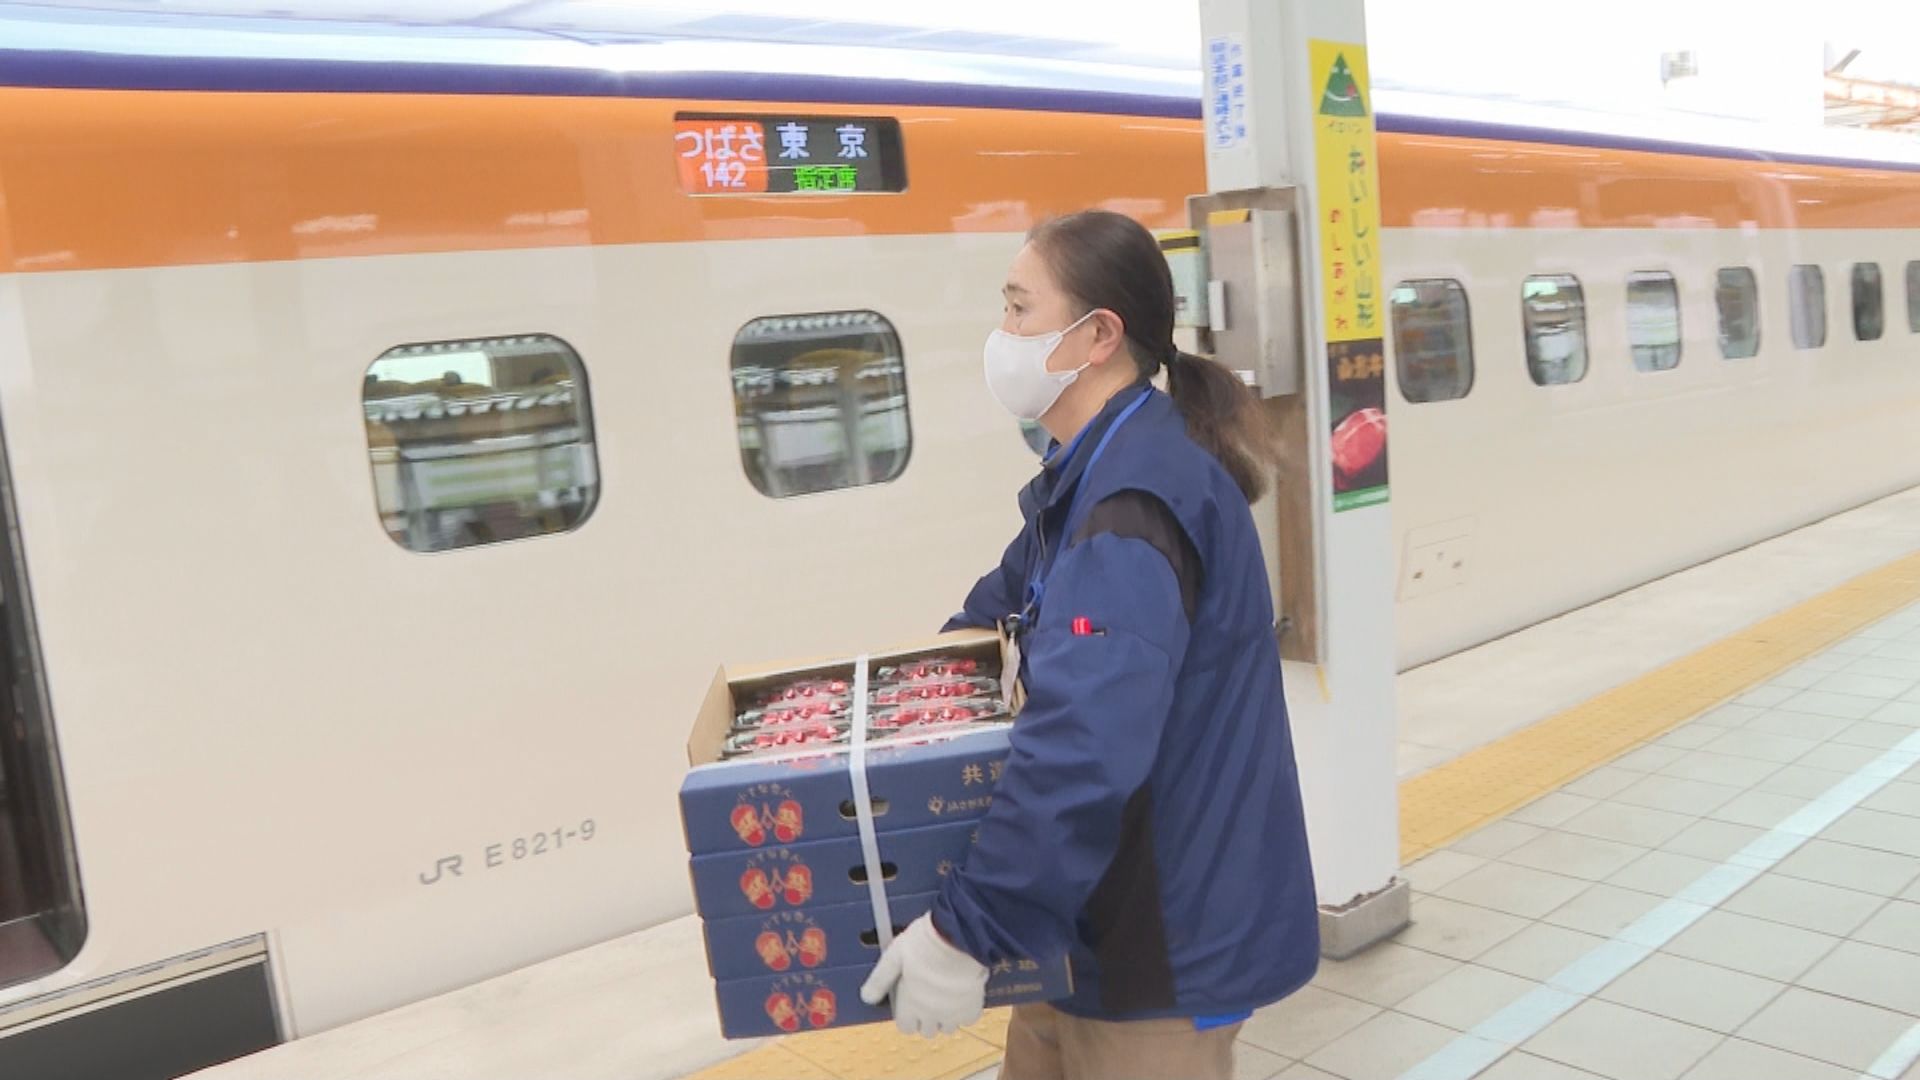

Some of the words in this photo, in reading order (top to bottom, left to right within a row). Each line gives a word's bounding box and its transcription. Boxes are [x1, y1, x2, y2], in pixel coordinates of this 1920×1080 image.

[675, 125, 763, 161] つばさ
[776, 122, 868, 160] 東京
[701, 161, 747, 188] 142
[419, 854, 464, 885] JR
[485, 818, 597, 868] E821-9
